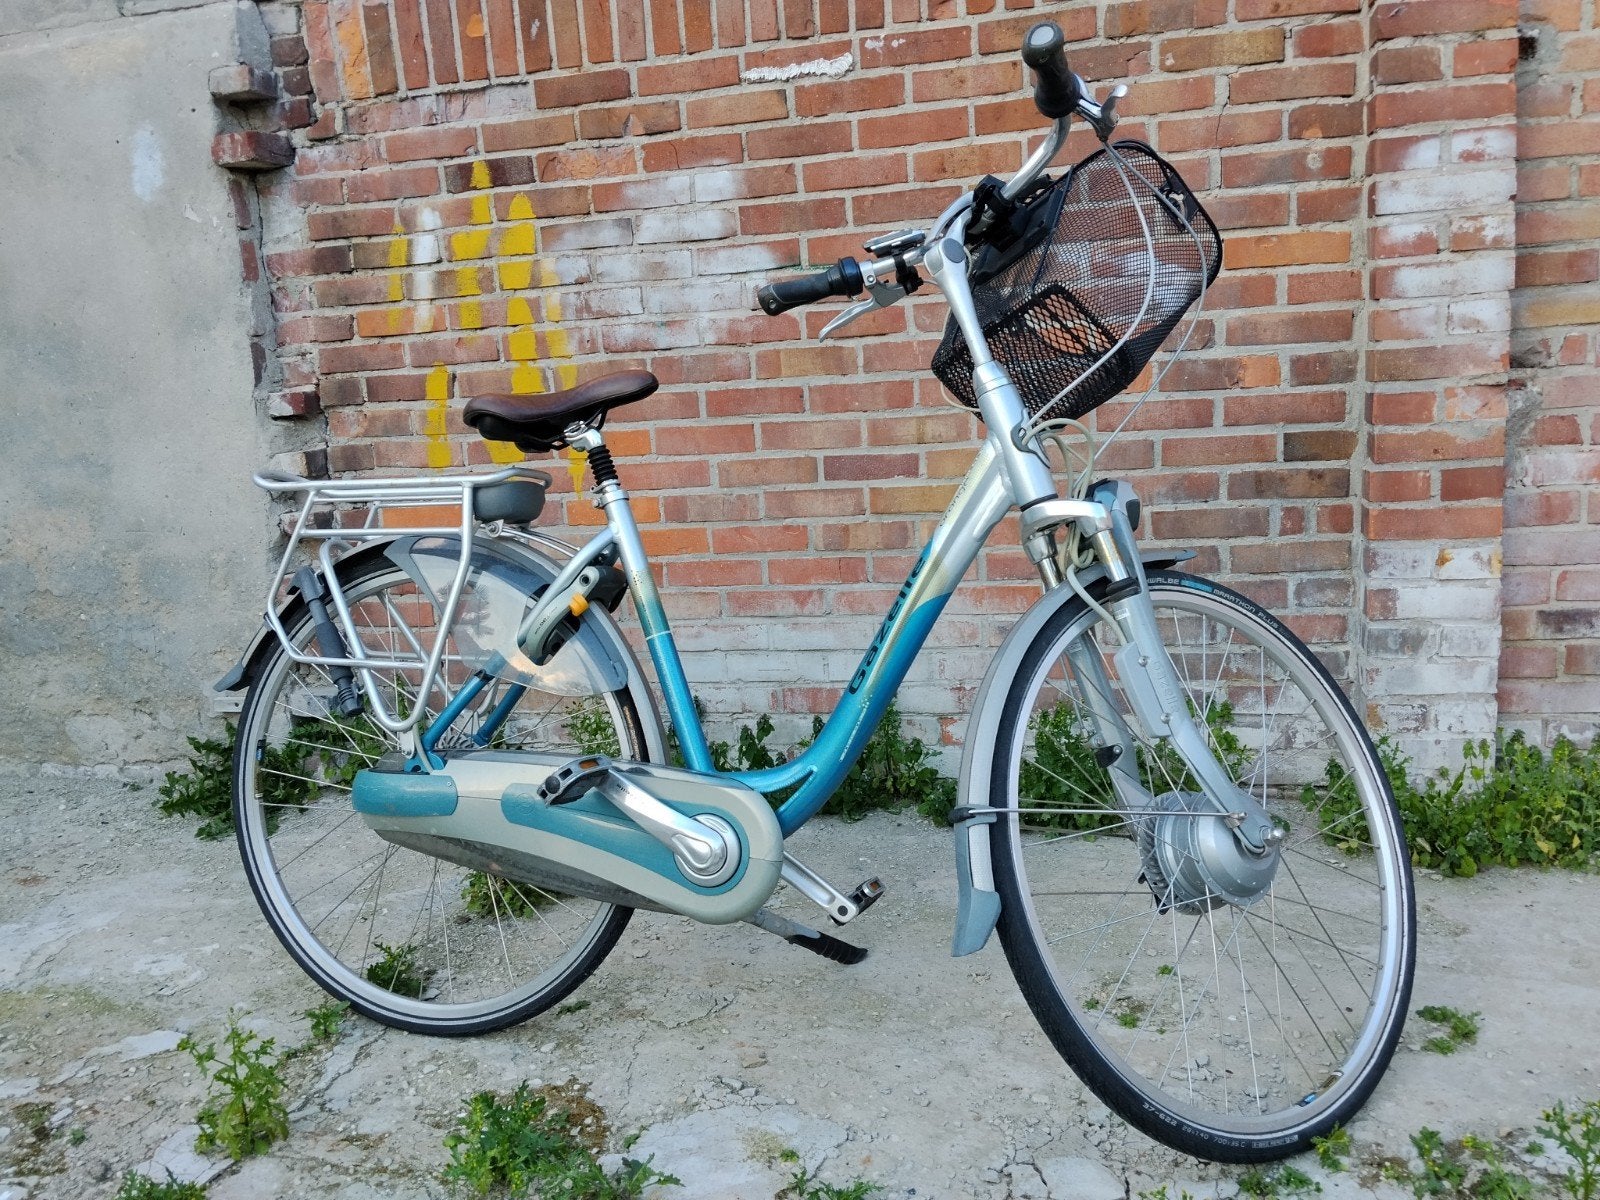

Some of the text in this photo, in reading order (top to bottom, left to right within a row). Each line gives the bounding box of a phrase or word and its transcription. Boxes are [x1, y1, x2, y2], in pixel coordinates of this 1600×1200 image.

[849, 557, 926, 694] Gazelle
[1146, 576, 1280, 629] WALBE MARATHON PLUS
[1142, 1101, 1178, 1127] 37-622
